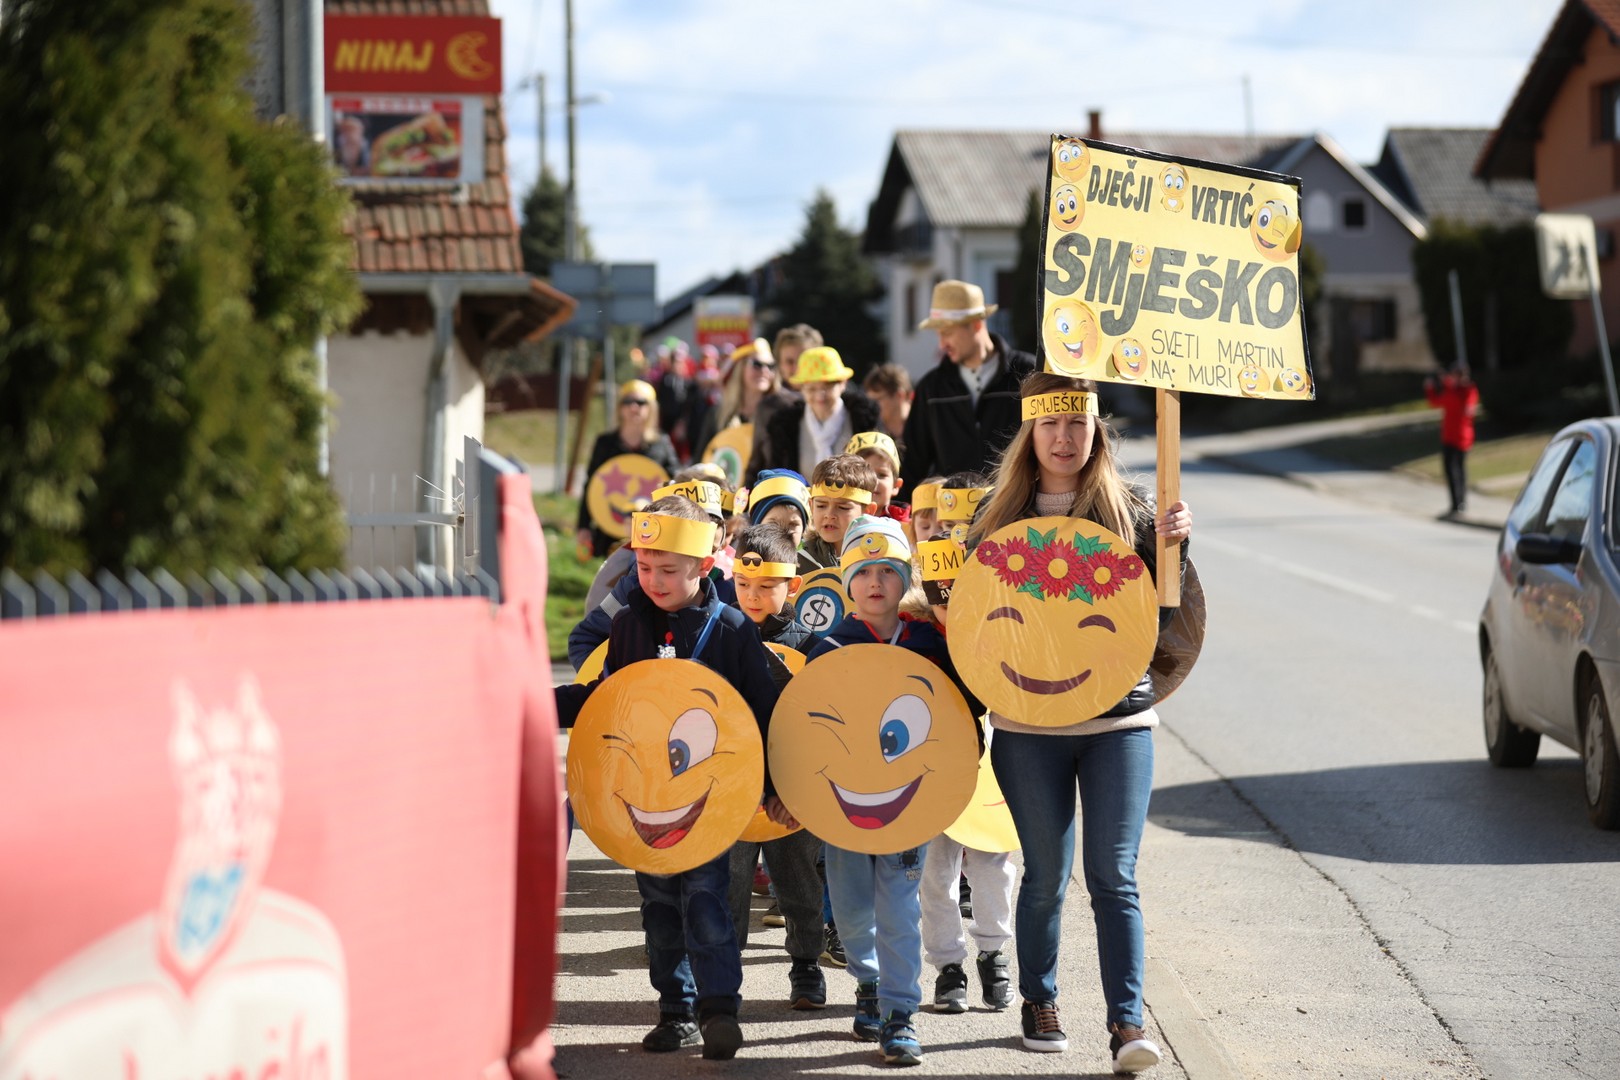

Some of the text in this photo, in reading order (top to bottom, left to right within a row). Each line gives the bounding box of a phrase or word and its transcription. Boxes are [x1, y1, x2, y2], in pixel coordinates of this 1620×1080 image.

[334, 39, 434, 72] NINAJ
[1086, 159, 1255, 229] DJEČJI VRTIĆ
[1151, 329, 1284, 368] SVETI MARTIN
[1151, 360, 1232, 388] NA MURI
